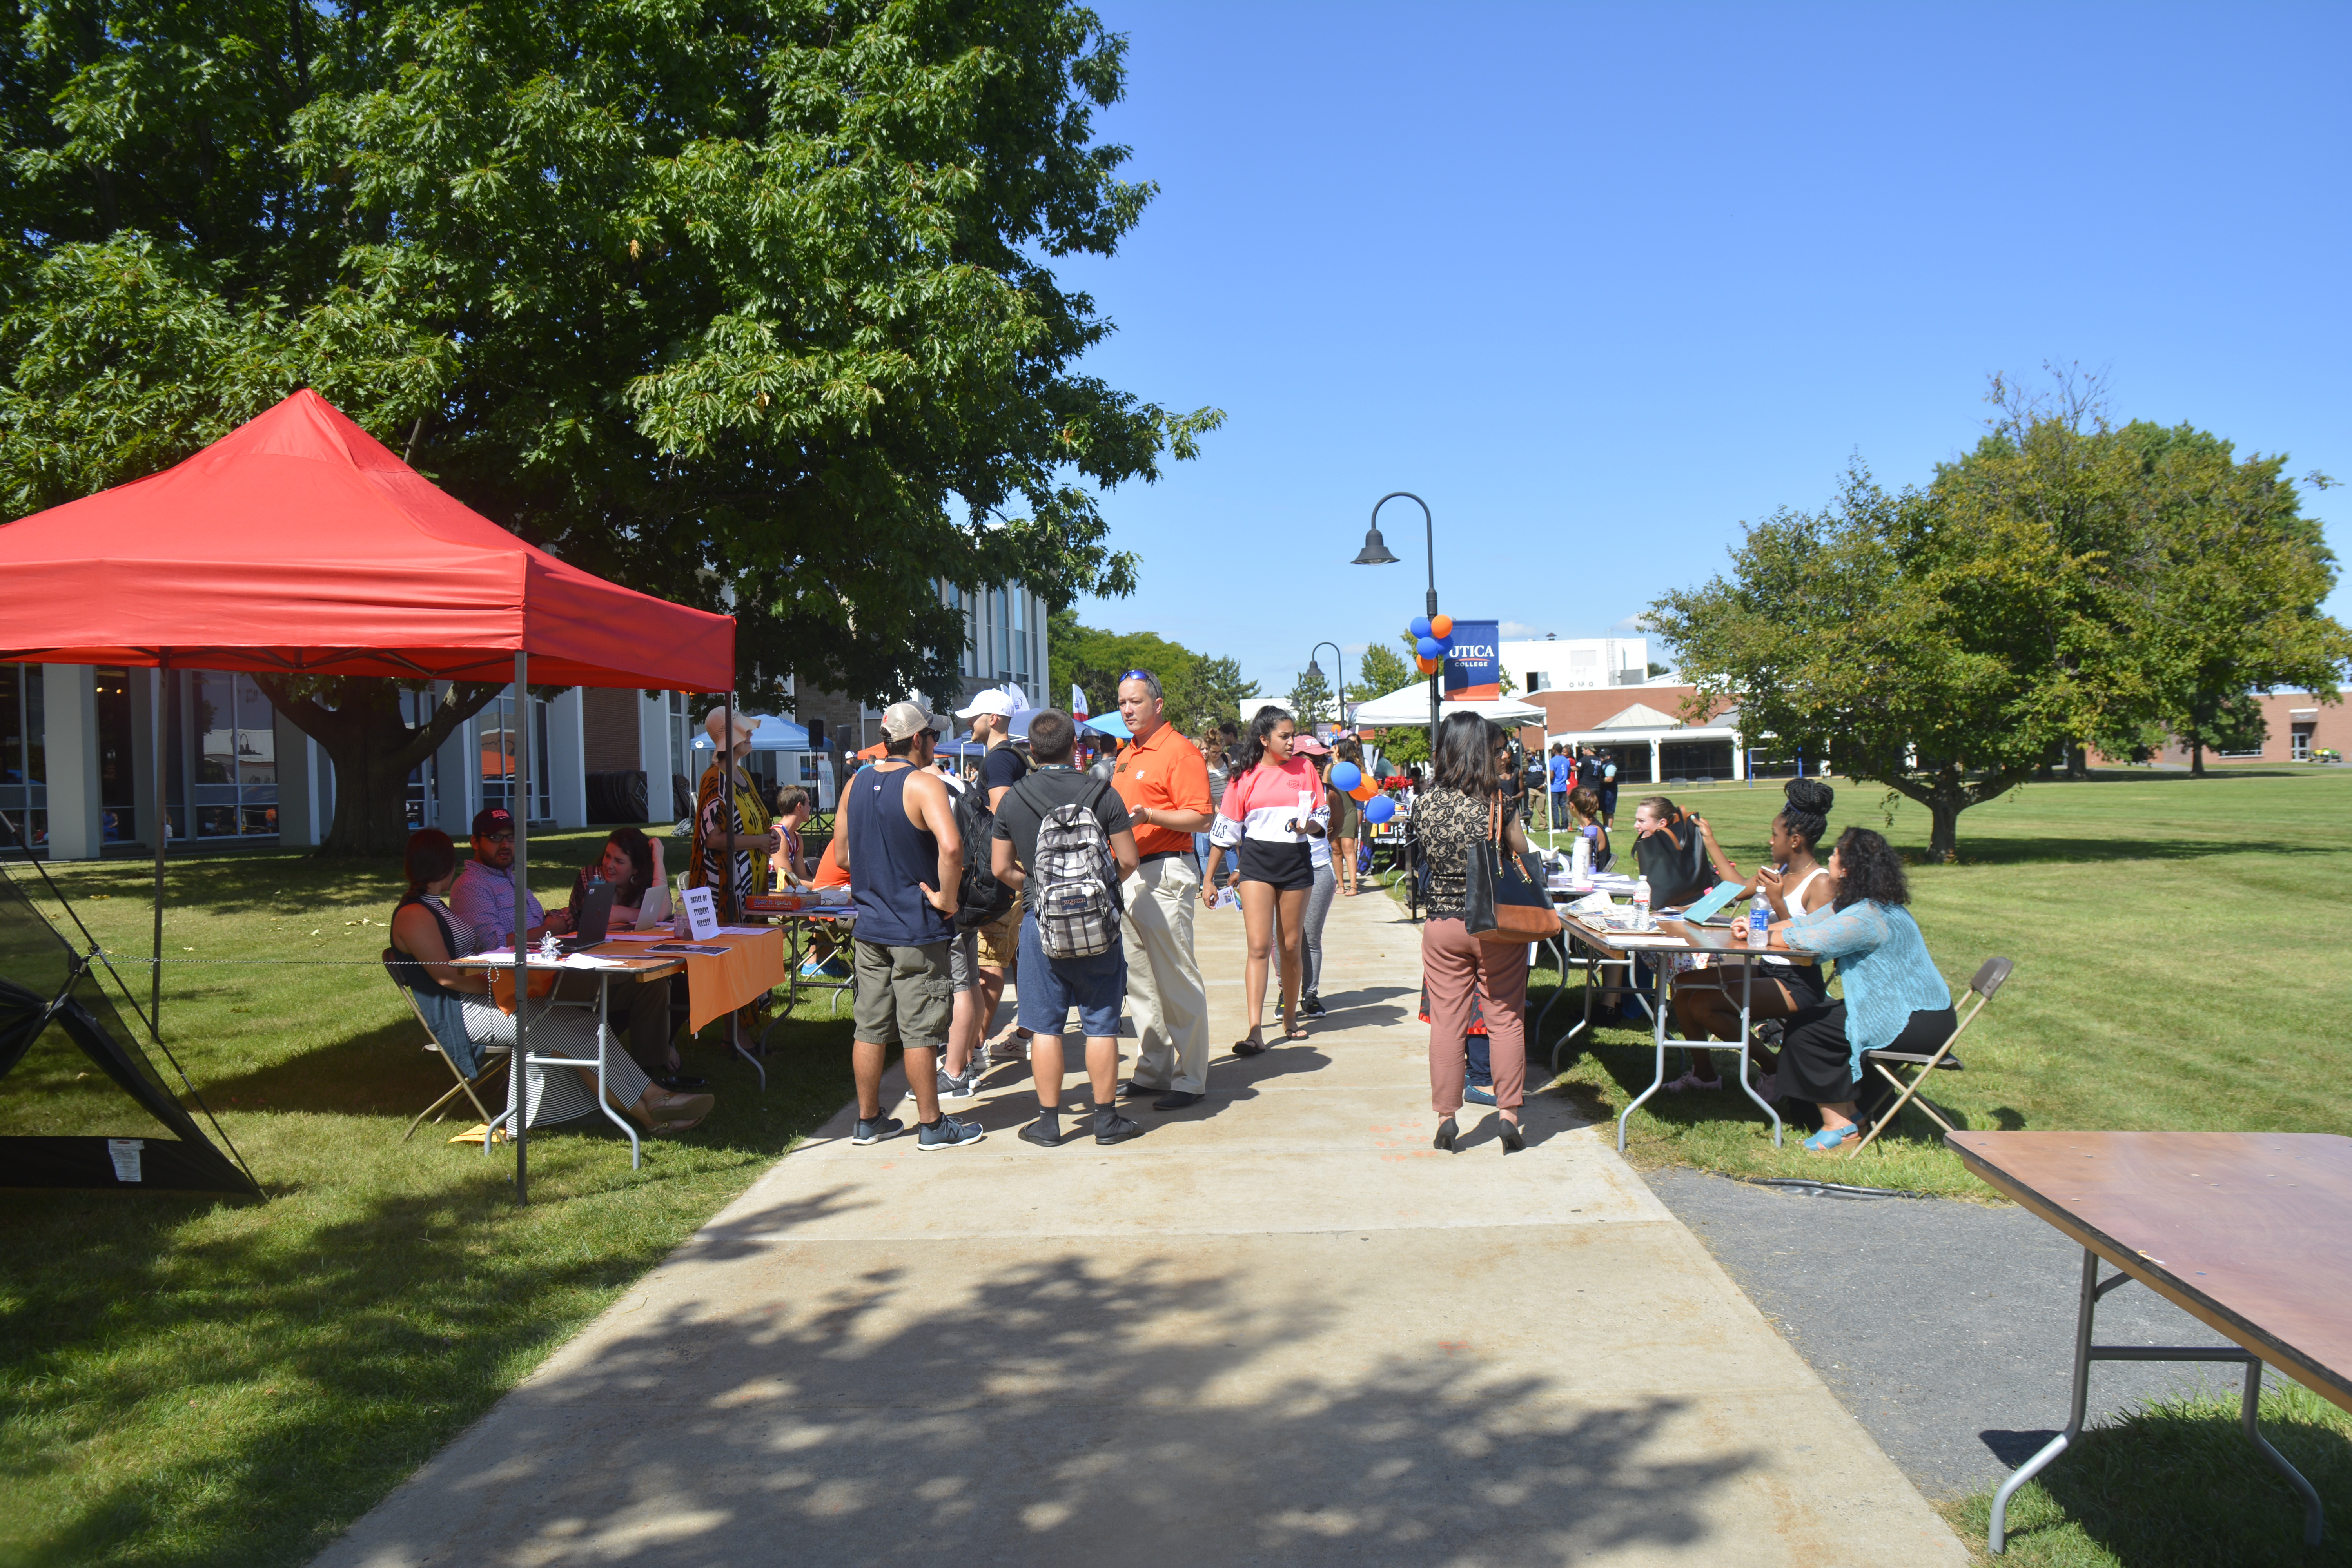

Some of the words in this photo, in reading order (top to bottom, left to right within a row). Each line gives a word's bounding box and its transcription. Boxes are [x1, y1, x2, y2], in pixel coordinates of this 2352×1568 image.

[1449, 645, 1495, 657] UTICA
[690, 895, 702, 904] OFFICE
[1062, 898, 1086, 906] JANSPORT
[694, 907, 709, 916] STUDENT
[697, 918, 711, 927] SUCCESS
